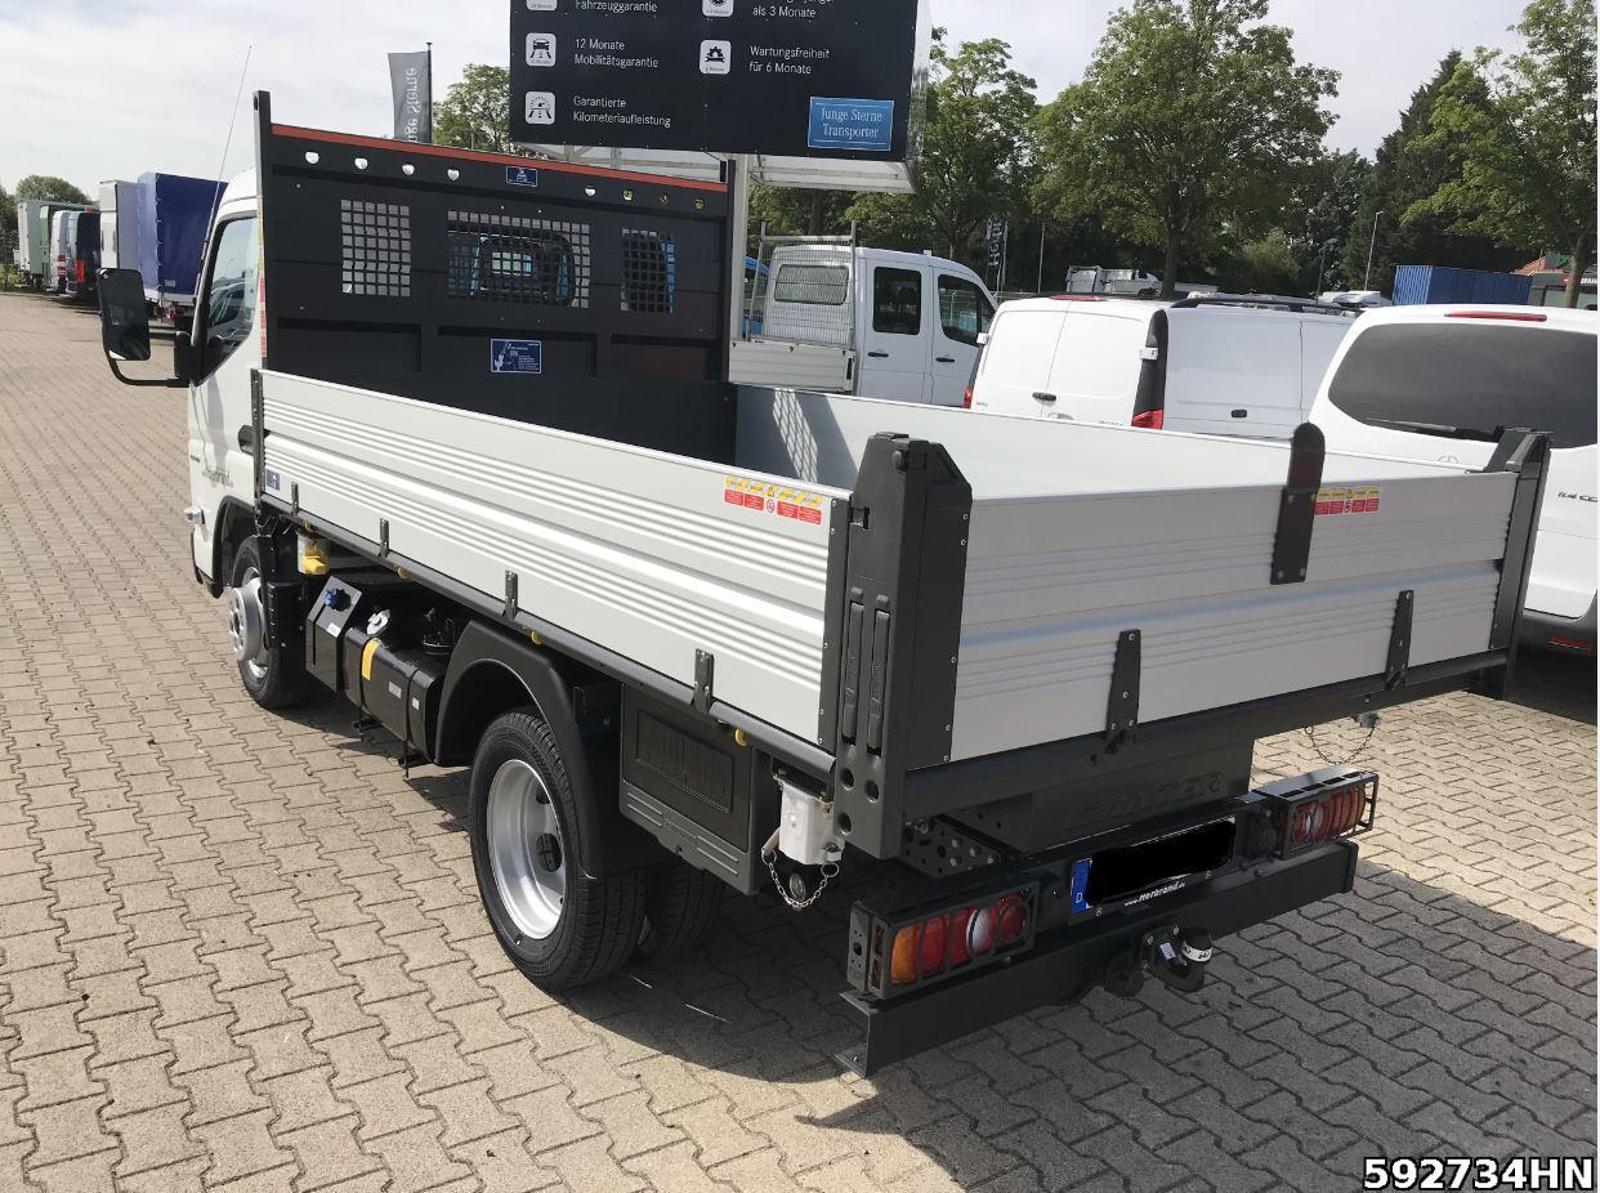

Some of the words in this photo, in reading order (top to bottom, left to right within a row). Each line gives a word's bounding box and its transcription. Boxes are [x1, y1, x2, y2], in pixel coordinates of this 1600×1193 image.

[752, 6, 766, 16] als
[769, 6, 776, 16] 3
[778, 7, 817, 18] Monate
[575, 39, 586, 48] 12
[589, 39, 625, 50] Monate
[750, 46, 830, 59] Wartungsfreiheit
[574, 54, 659, 69] Mobilitätsgarantie
[749, 61, 762, 72] für
[766, 62, 772, 72] 6
[774, 63, 812, 74] Monate
[573, 96, 627, 108] Garantierte
[572, 111, 671, 128] Kilometerlaufleistung
[821, 108, 849, 123] Junge
[850, 109, 883, 122] Sterne
[822, 123, 880, 140] Transporter
[1075, 892, 1083, 904] D
